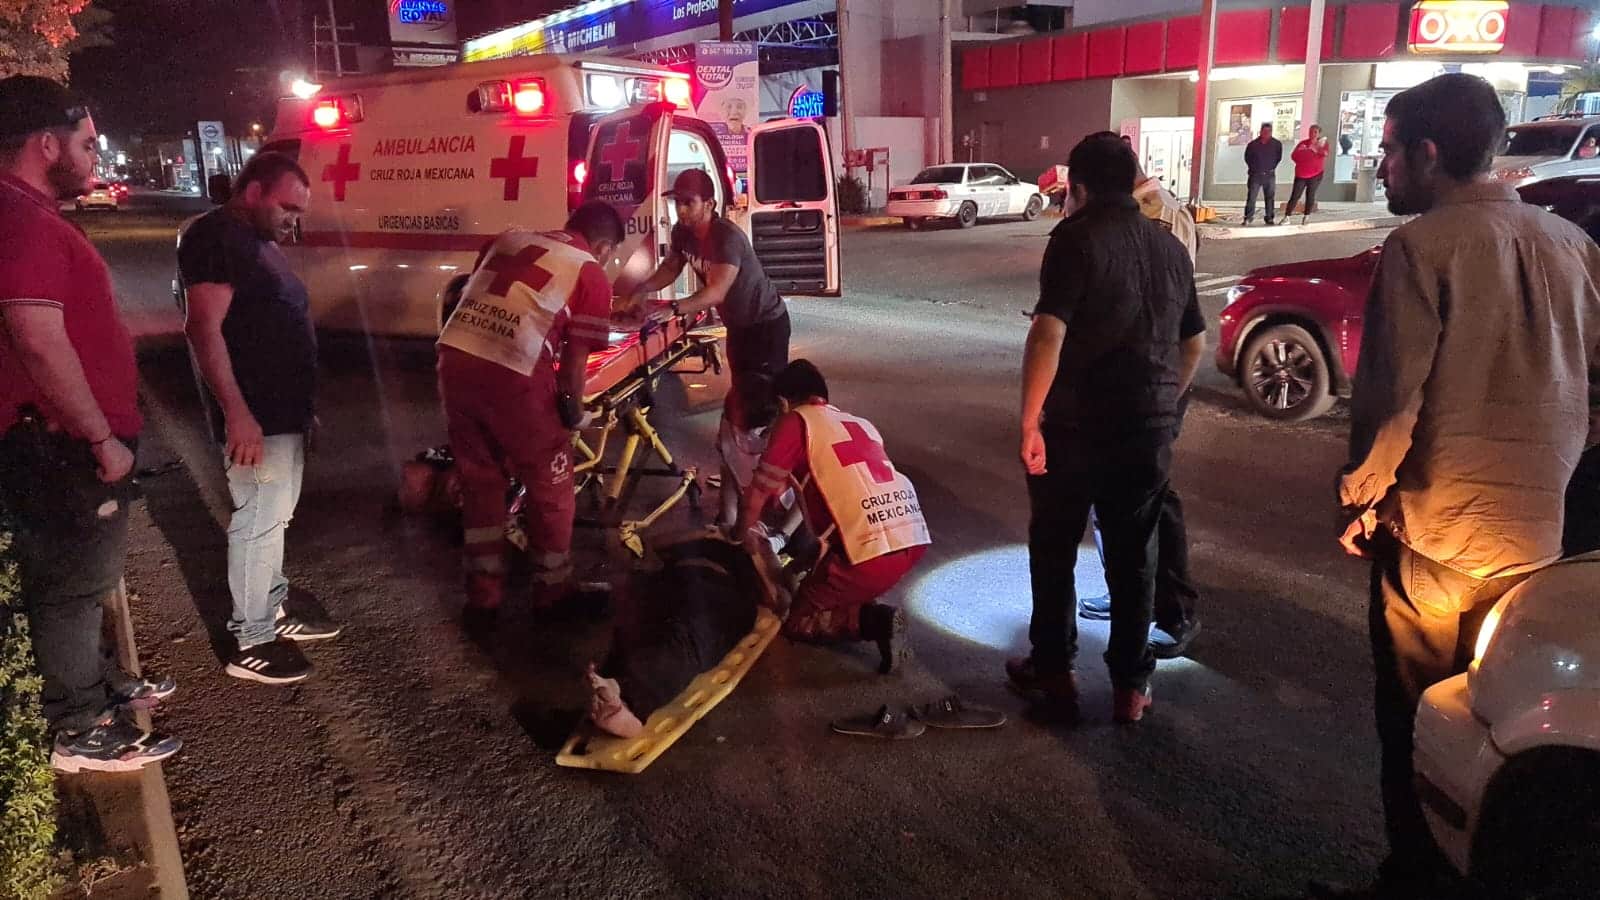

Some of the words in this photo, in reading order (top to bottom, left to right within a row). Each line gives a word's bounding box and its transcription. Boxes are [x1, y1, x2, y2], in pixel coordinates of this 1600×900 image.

[673, 6, 685, 20] Los
[686, 0, 719, 17] Profesio
[567, 20, 616, 49] MICHELIN
[1419, 10, 1505, 42] OXXO
[696, 65, 731, 73] DENTAL
[700, 72, 727, 80] TOTAL
[373, 135, 475, 157] AMBULANCIA
[370, 168, 395, 181] CRUZ
[397, 168, 421, 181] ROJA
[424, 167, 475, 180] MEXICANA
[598, 183, 616, 192] CRUZ
[617, 181, 635, 190] ROJA
[378, 215, 421, 230] URGENCIAS
[423, 215, 460, 230] BASICAS
[489, 305, 521, 327] ROJA
[861, 493, 893, 510] CRUZ
